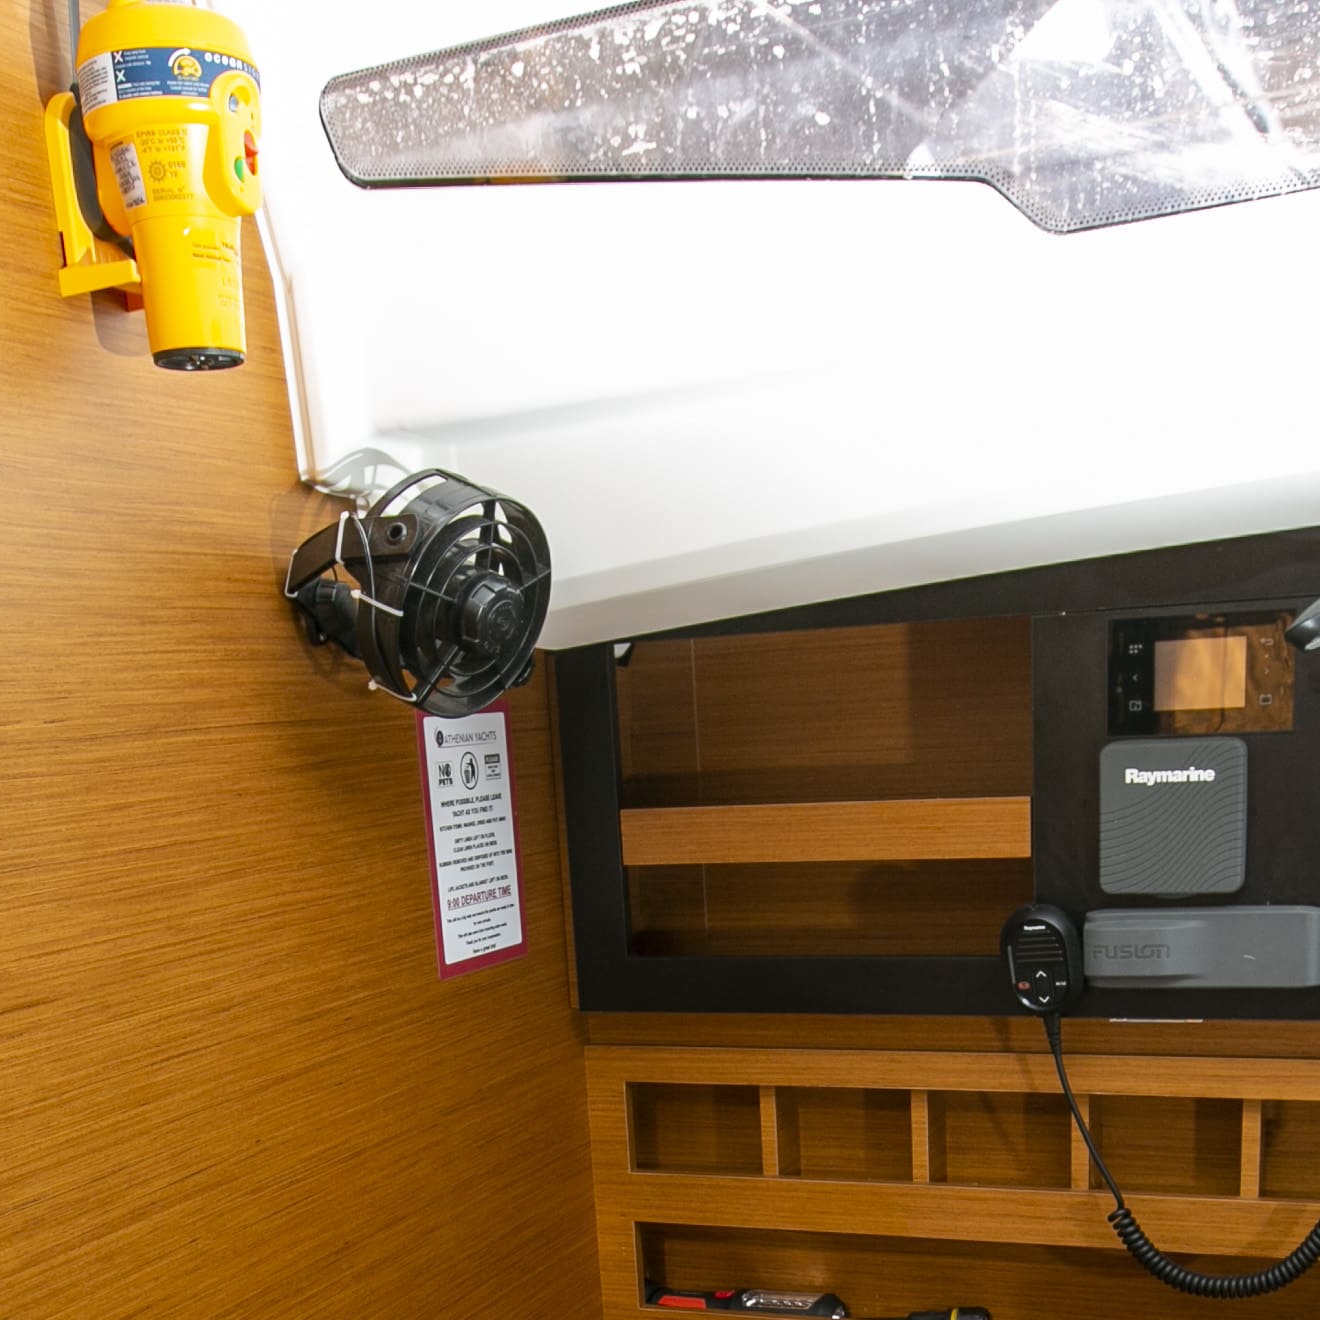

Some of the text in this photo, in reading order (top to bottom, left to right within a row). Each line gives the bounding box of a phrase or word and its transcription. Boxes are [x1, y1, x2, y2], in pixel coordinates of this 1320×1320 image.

[445, 730, 497, 744] ATHENIAN YACHTS
[439, 778, 453, 786] PETS
[1125, 766, 1216, 786] Raymarine
[447, 885, 511, 909] 9:00 DEPARTURE TIME
[1092, 944, 1171, 960] FUSION
